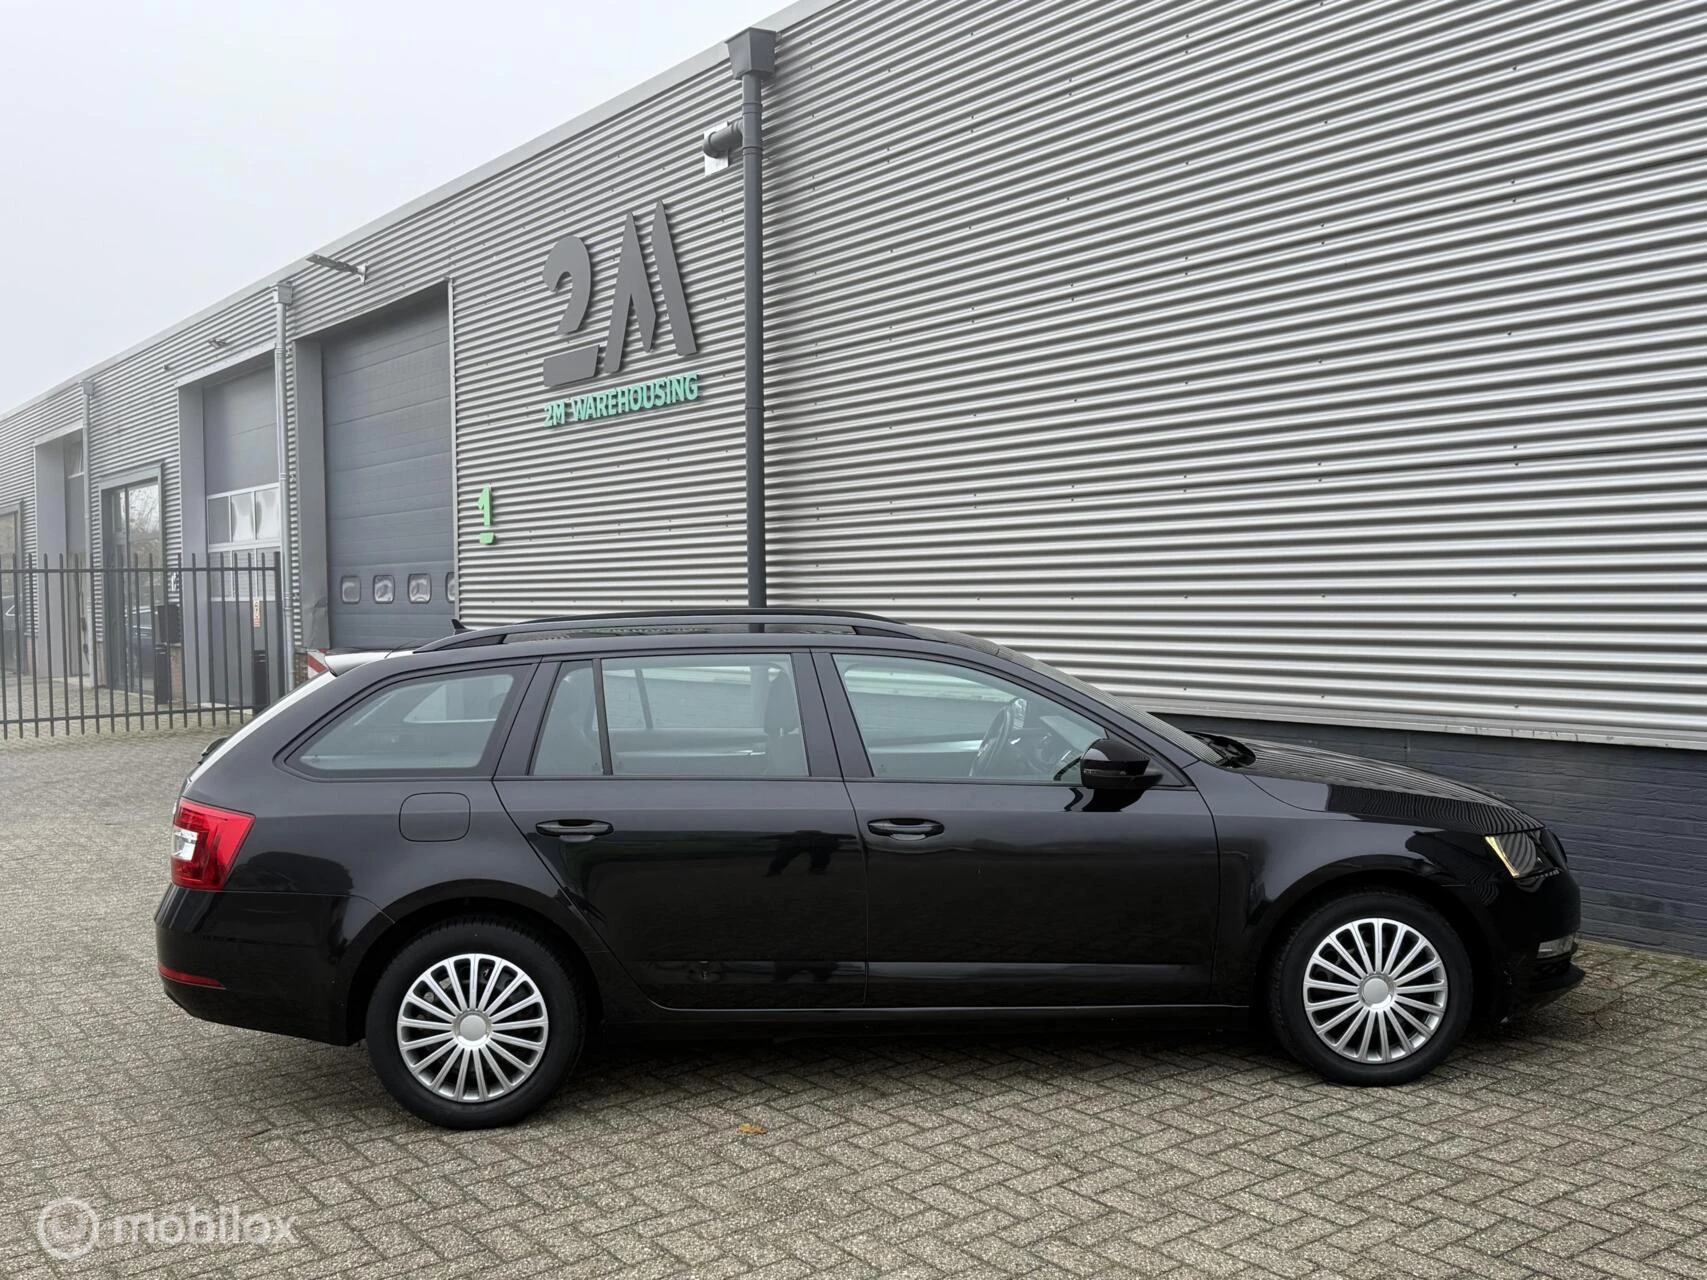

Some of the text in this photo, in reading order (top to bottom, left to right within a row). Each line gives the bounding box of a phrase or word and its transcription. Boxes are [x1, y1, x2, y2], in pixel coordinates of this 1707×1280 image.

[543, 200, 697, 387] 2M
[543, 373, 699, 427] 2M WAREHOUSING
